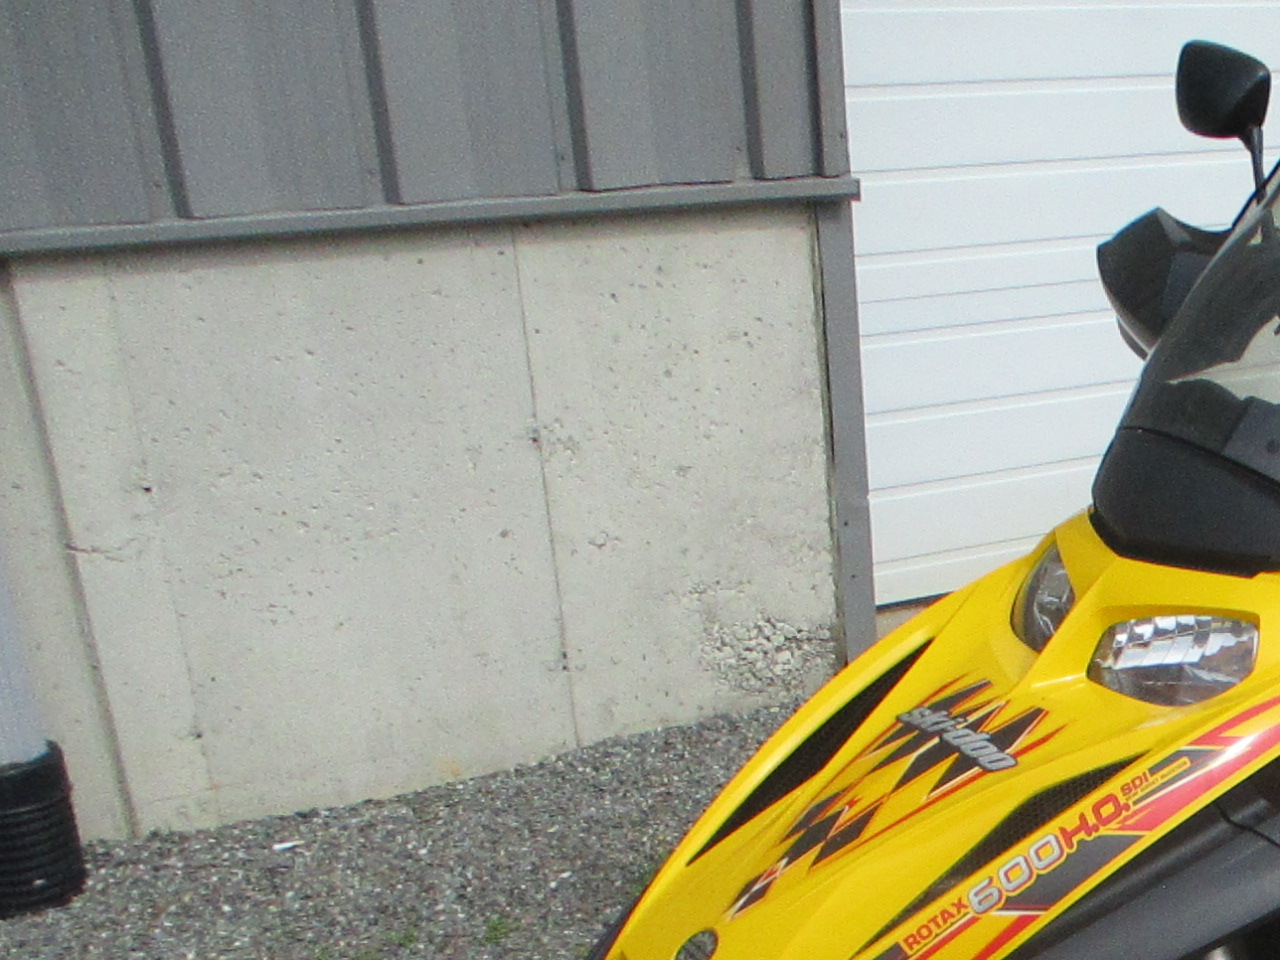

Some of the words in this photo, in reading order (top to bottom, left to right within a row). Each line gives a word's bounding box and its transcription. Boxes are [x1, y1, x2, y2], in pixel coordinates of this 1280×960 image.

[902, 898, 970, 951] ROTAX
[967, 833, 1063, 915] 600
[1120, 771, 1149, 796] SDI
